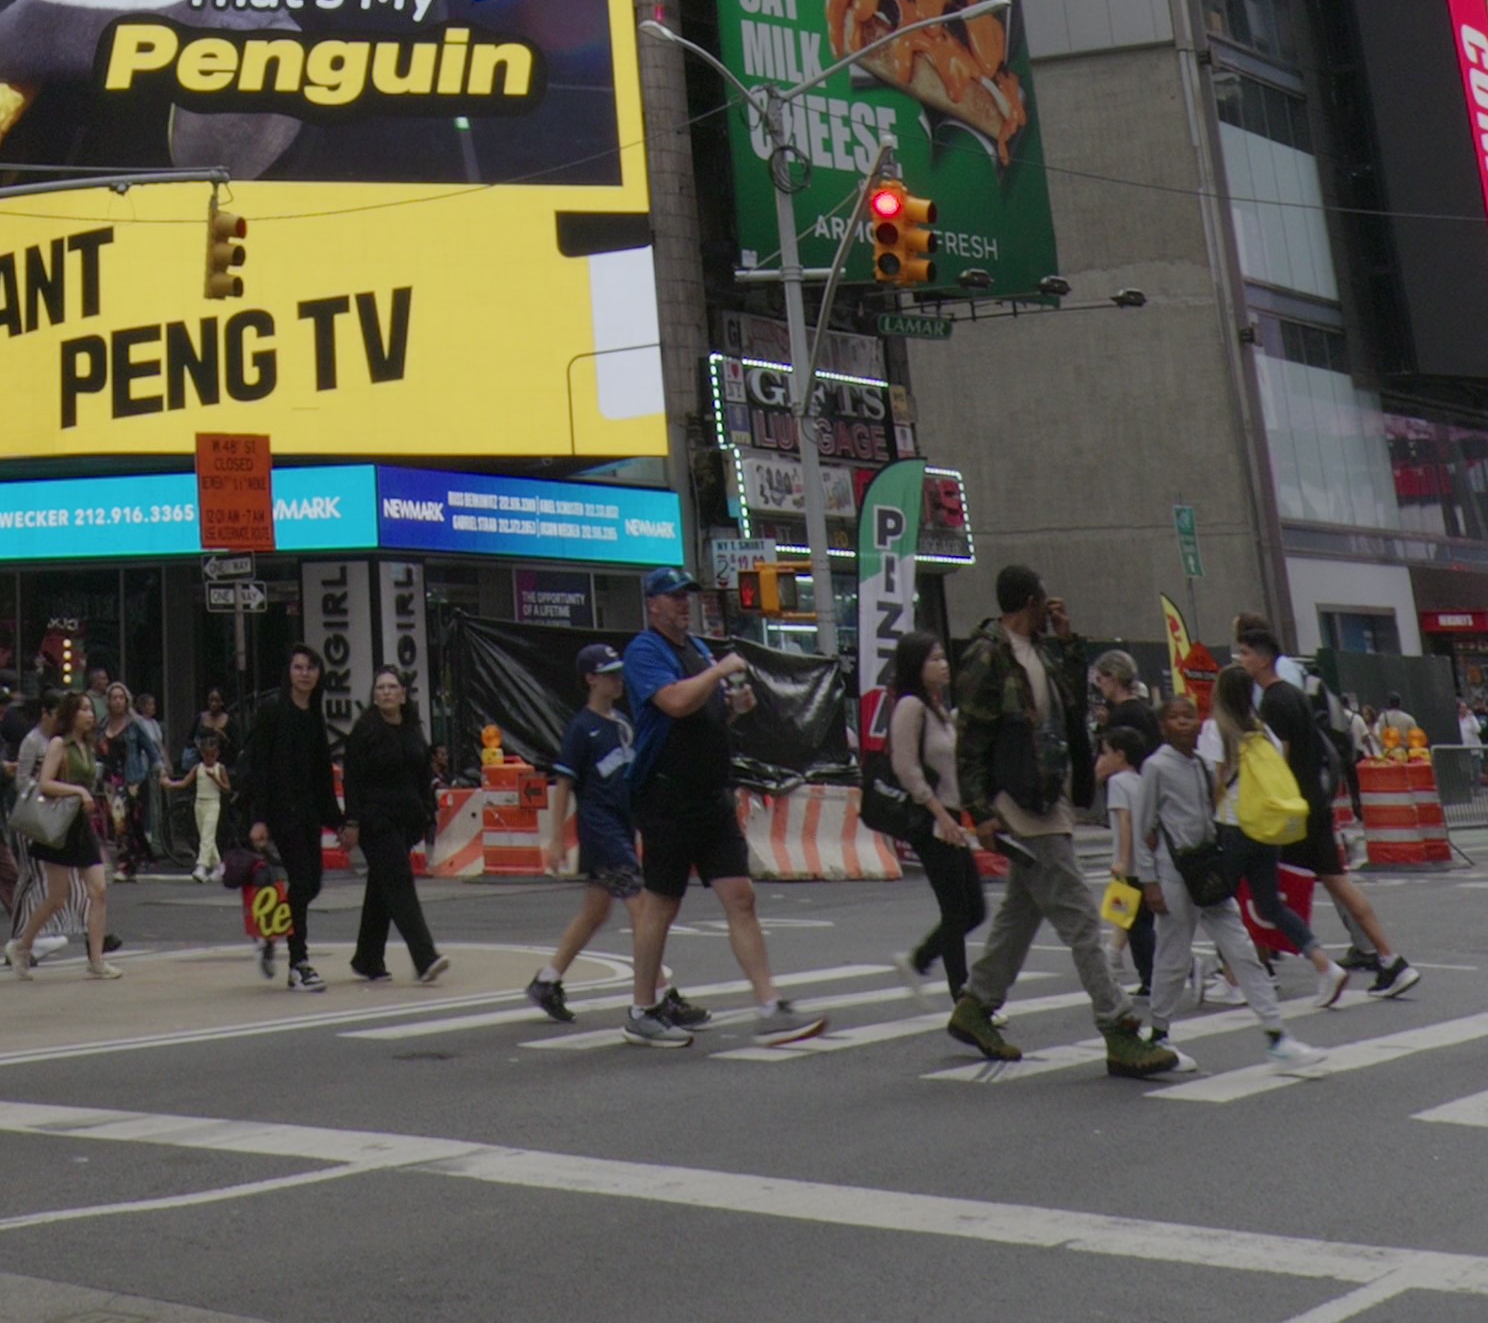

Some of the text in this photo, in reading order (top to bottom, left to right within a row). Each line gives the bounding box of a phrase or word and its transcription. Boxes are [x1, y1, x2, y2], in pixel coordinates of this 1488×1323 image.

[103, 22, 536, 109] Penguin
[740, 19, 827, 89] MILK
[747, 84, 903, 180] CHEESE
[814, 215, 1000, 262] ARMO FRESH
[883, 315, 946, 337] LAMAR
[60, 286, 413, 430] PENG TV
[745, 366, 887, 421] GFTS
[754, 410, 890, 461] LUGAGE
[213, 457, 254, 472] CLOSED
[73, 503, 196, 527] 212.916.3365
[273, 496, 342, 521] MARK
[383, 498, 445, 522] NEWMARK
[624, 518, 676, 539] NEWMARK
[210, 558, 250, 574] ONE WAY
[212, 589, 230, 603] ONE
[536, 591, 586, 606] OPPORTUNITY
